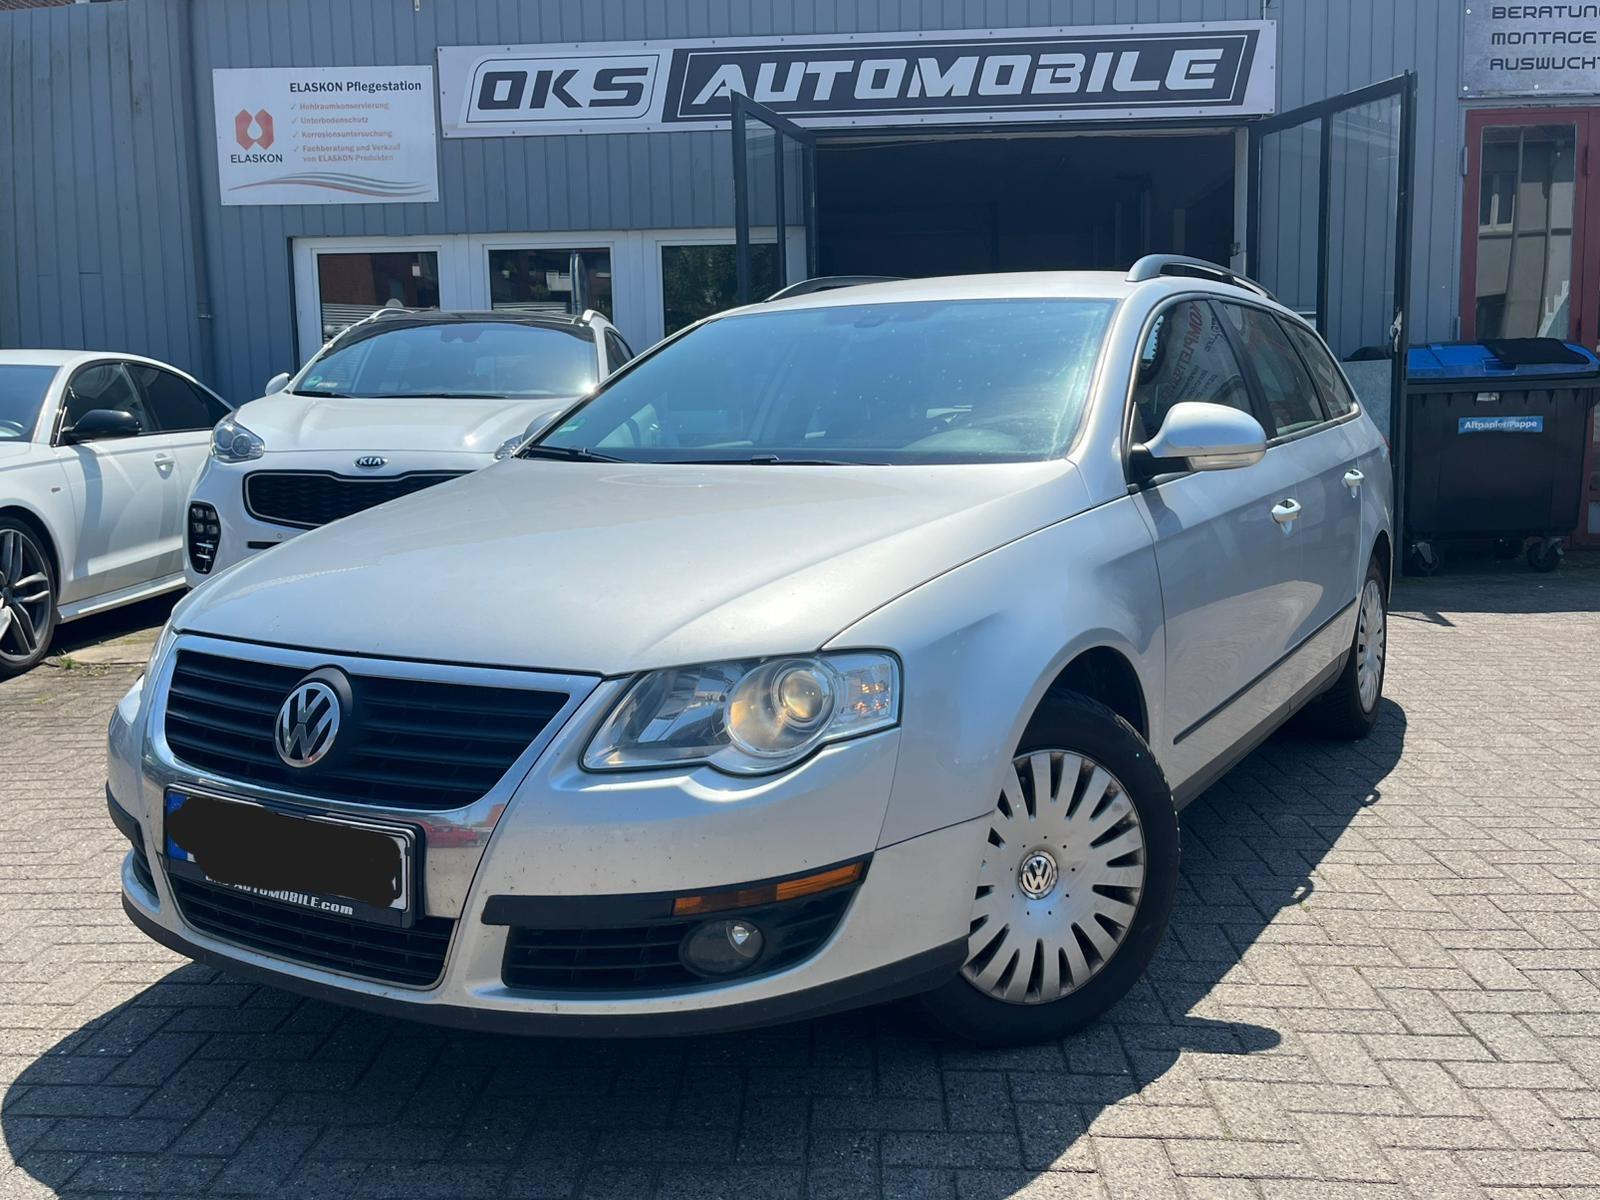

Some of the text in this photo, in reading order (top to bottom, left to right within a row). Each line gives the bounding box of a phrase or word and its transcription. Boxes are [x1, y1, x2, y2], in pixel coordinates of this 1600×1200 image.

[1492, 5, 1600, 19] BERATUN
[1491, 31, 1597, 45] MONTAGE
[477, 48, 1225, 111] OKS AUTOMOBILE
[289, 80, 422, 93] ELASKON Pflegestation
[299, 101, 390, 111] Hohlraumkonservierung
[300, 116, 369, 125] Unterbodenschutz
[301, 130, 393, 139] Korrosionsuntersuchung
[356, 144, 370, 152] und
[231, 153, 283, 164] ELASKON
[359, 457, 382, 465] KIA
[275, 682, 341, 768] VW
